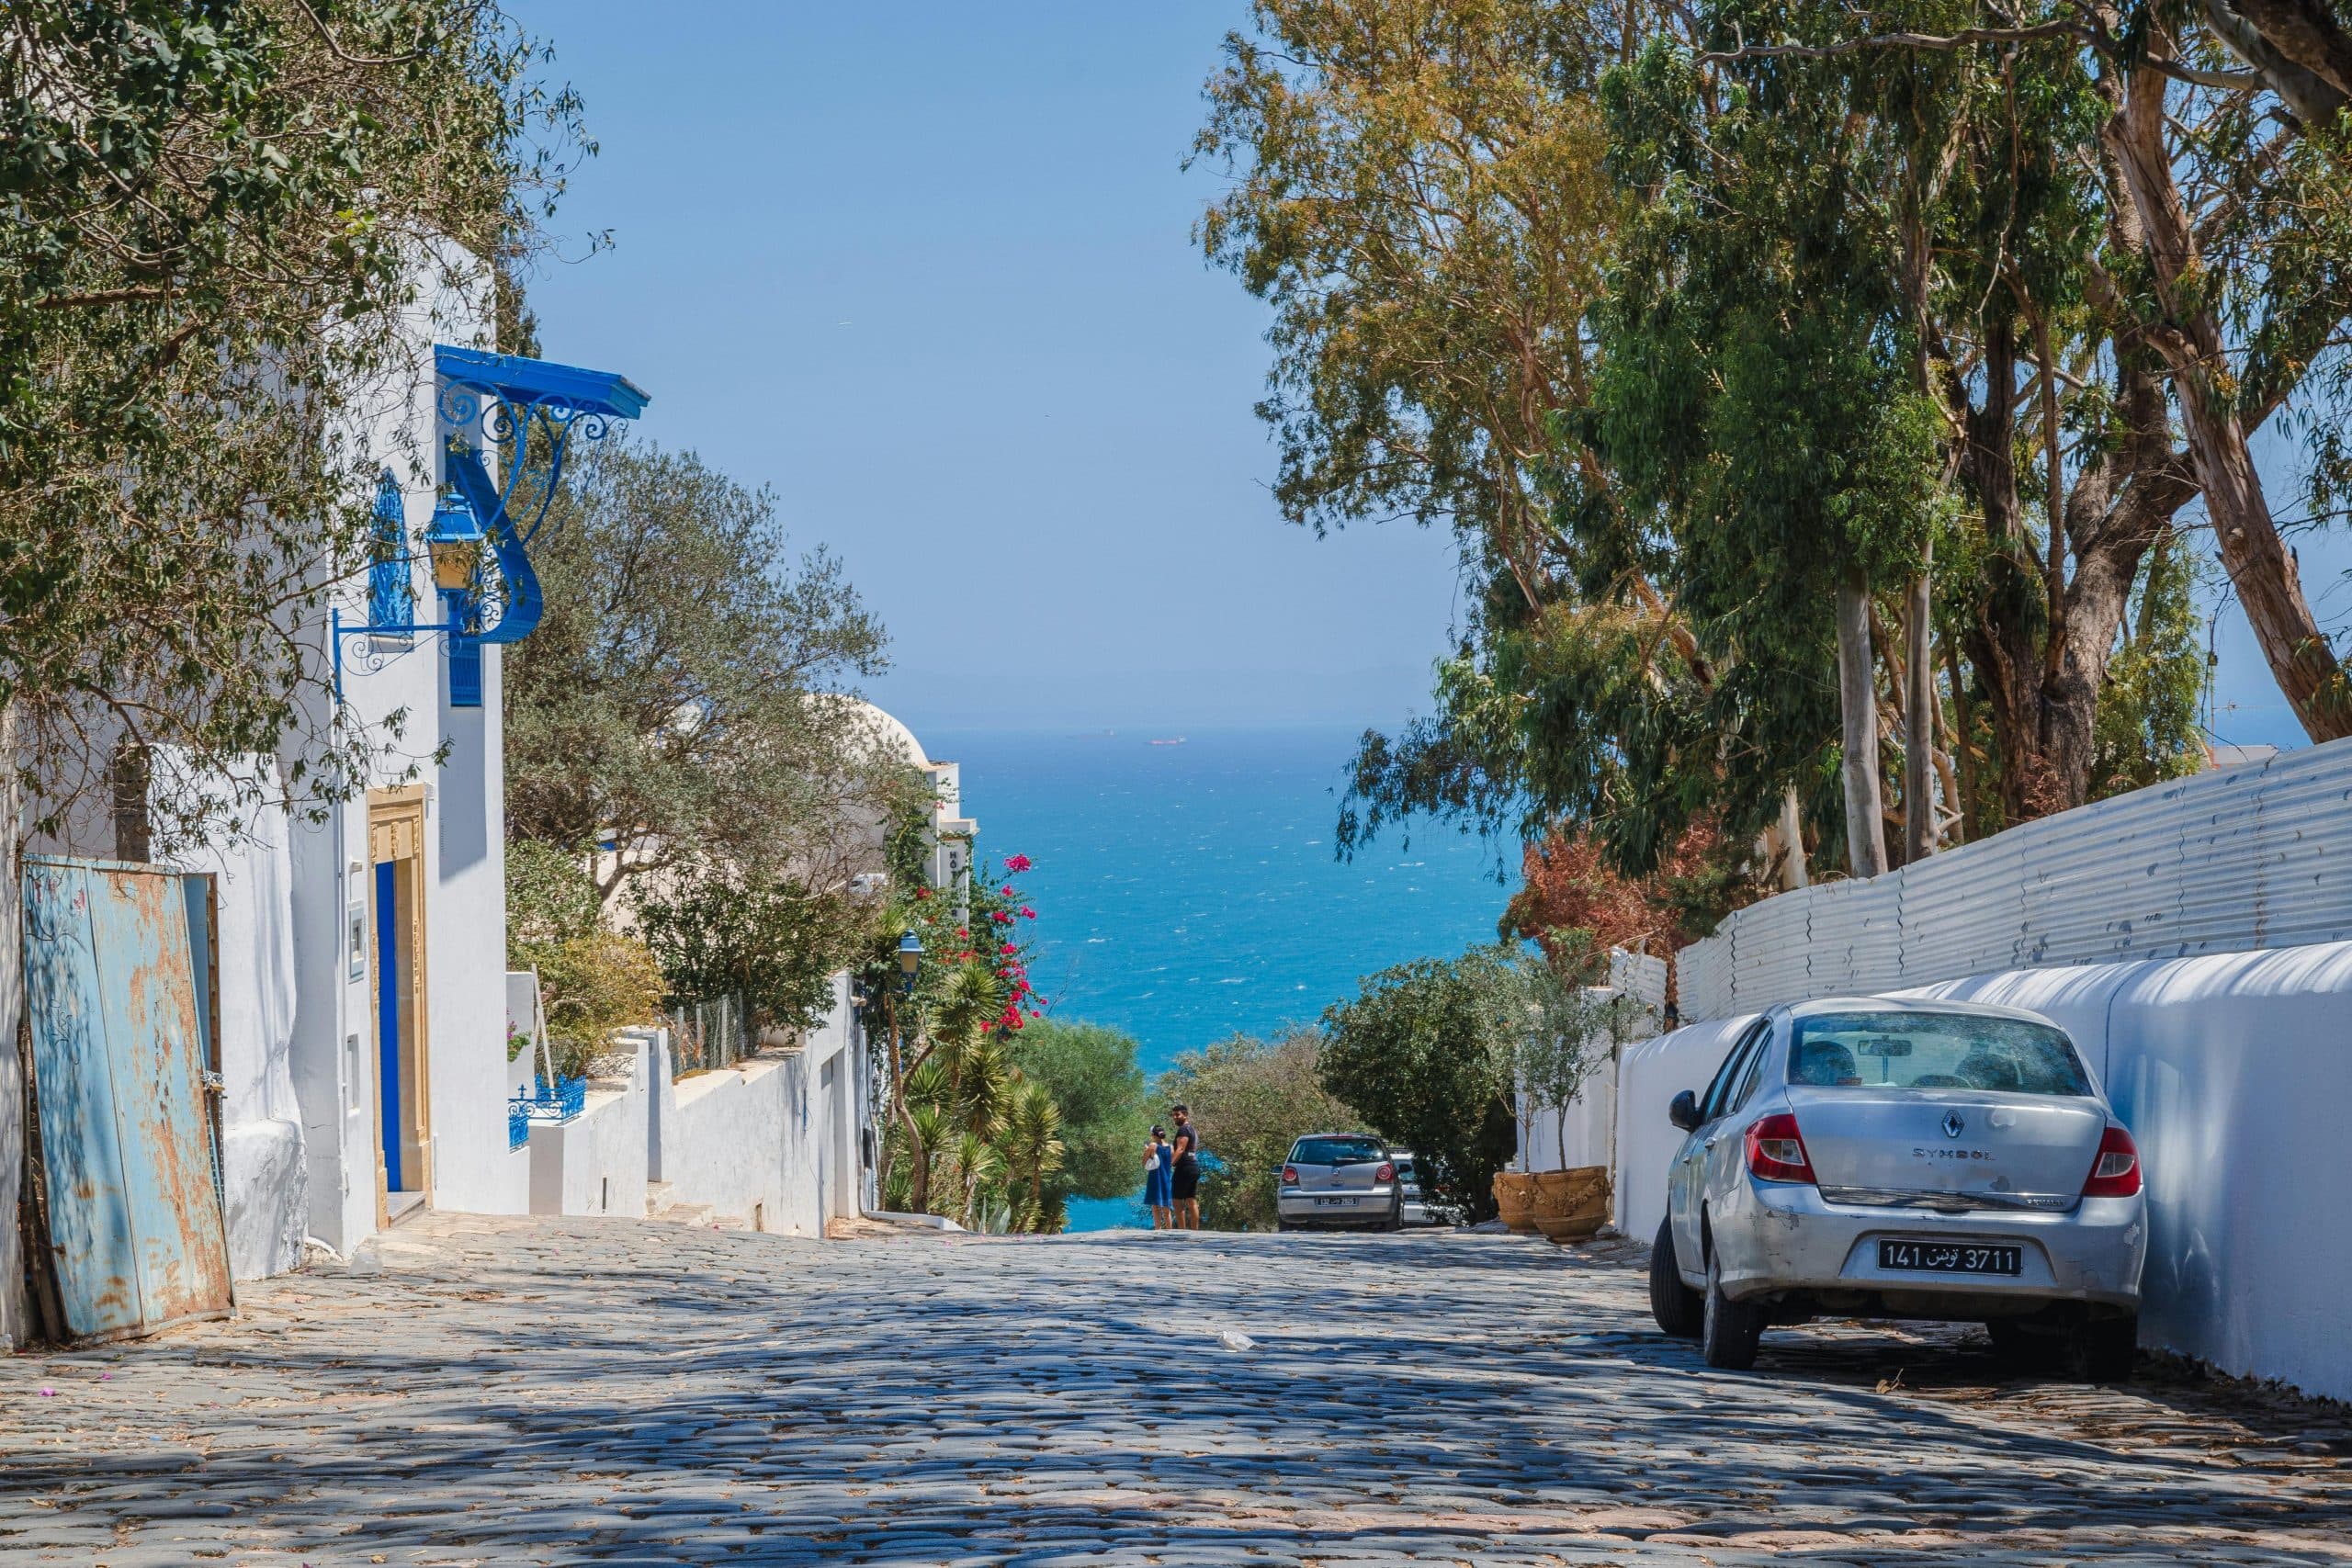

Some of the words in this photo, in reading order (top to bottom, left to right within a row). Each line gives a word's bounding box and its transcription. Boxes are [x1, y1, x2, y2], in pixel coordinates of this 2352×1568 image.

[1912, 1148, 1996, 1161] SYMBOL
[1886, 1246, 1919, 1267] 141
[1927, 1247, 1959, 1268] تونس
[1965, 1249, 2013, 1270] 3711
